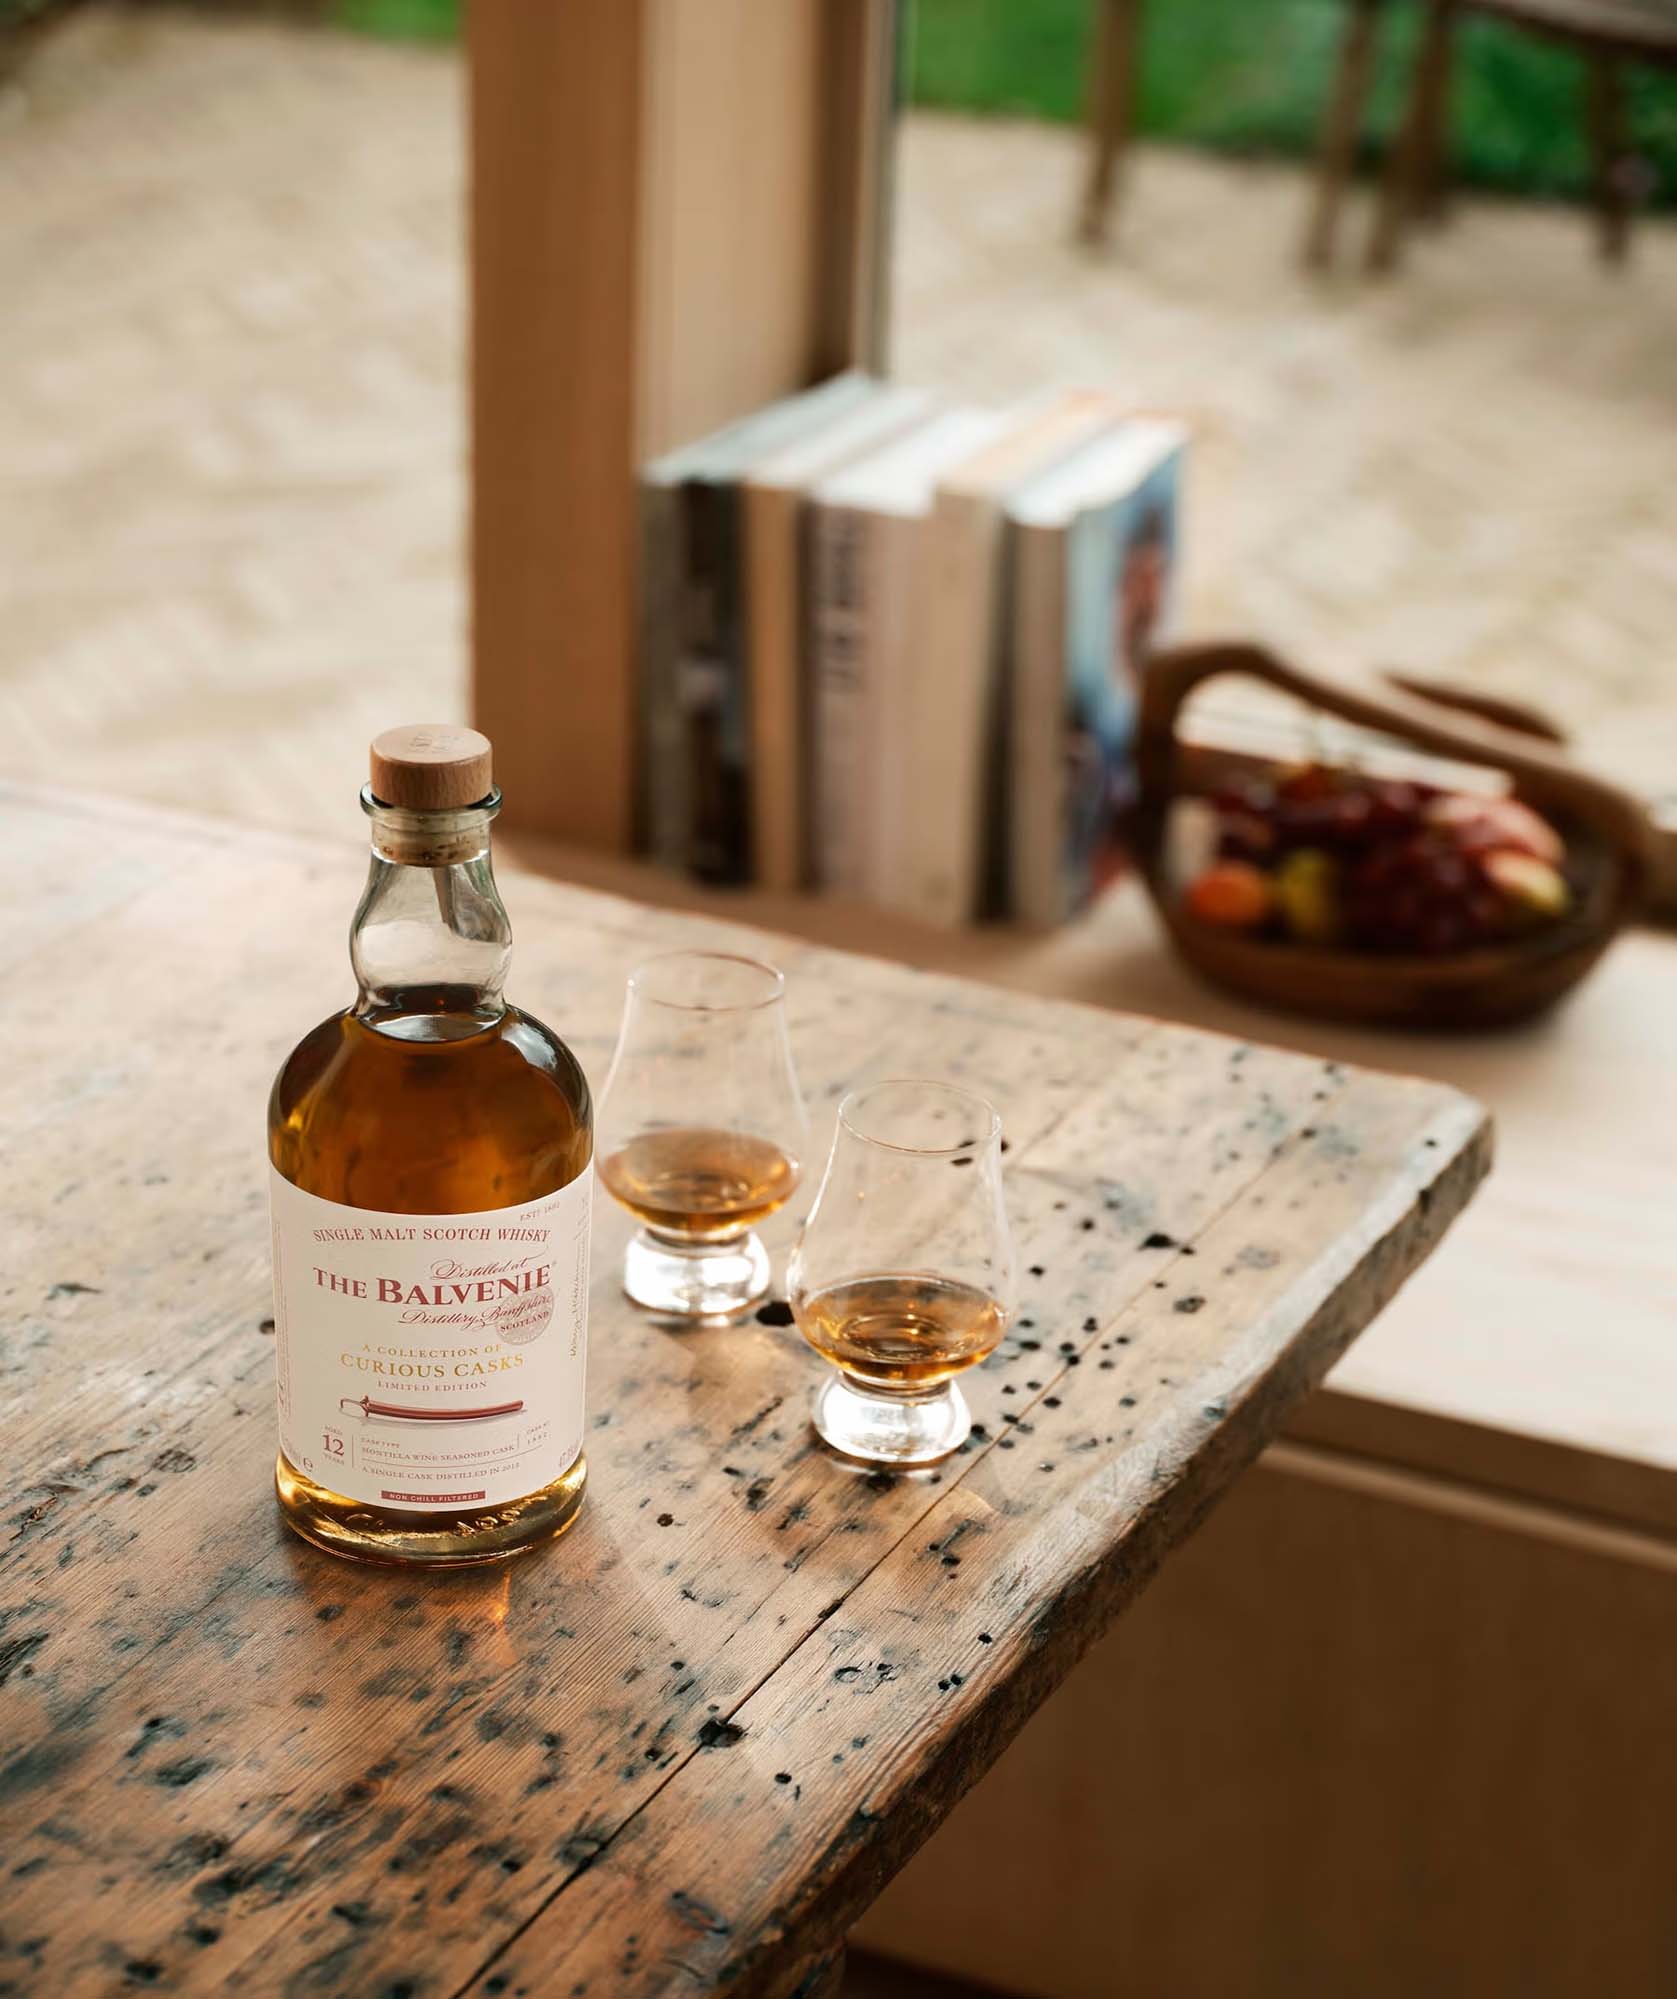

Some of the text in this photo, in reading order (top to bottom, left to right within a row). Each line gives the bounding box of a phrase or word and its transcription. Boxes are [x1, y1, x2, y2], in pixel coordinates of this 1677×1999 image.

[313, 1229, 550, 1242] SINGLE MALT SCOTCH WHISKY
[430, 1259, 512, 1279] Distilled
[313, 1264, 551, 1306] THE BALVENIE
[500, 1311, 549, 1331] SCOTLAND
[362, 1344, 501, 1359] A COLLECTION OF
[340, 1353, 524, 1378] CURIOUS CASKS
[377, 1380, 487, 1391] LIMITED EDITION
[322, 1434, 345, 1456] 12
[440, 1450, 490, 1461] SEASONED
[493, 1445, 515, 1455] CASK
[362, 1466, 368, 1474] A
[370, 1468, 406, 1478] SINGLE
[408, 1472, 433, 1480] CASK
[436, 1470, 487, 1480] DISTILLED
[490, 1467, 500, 1476] IN
[389, 1493, 408, 1501] NON
[439, 1492, 479, 1502] FILTERED
